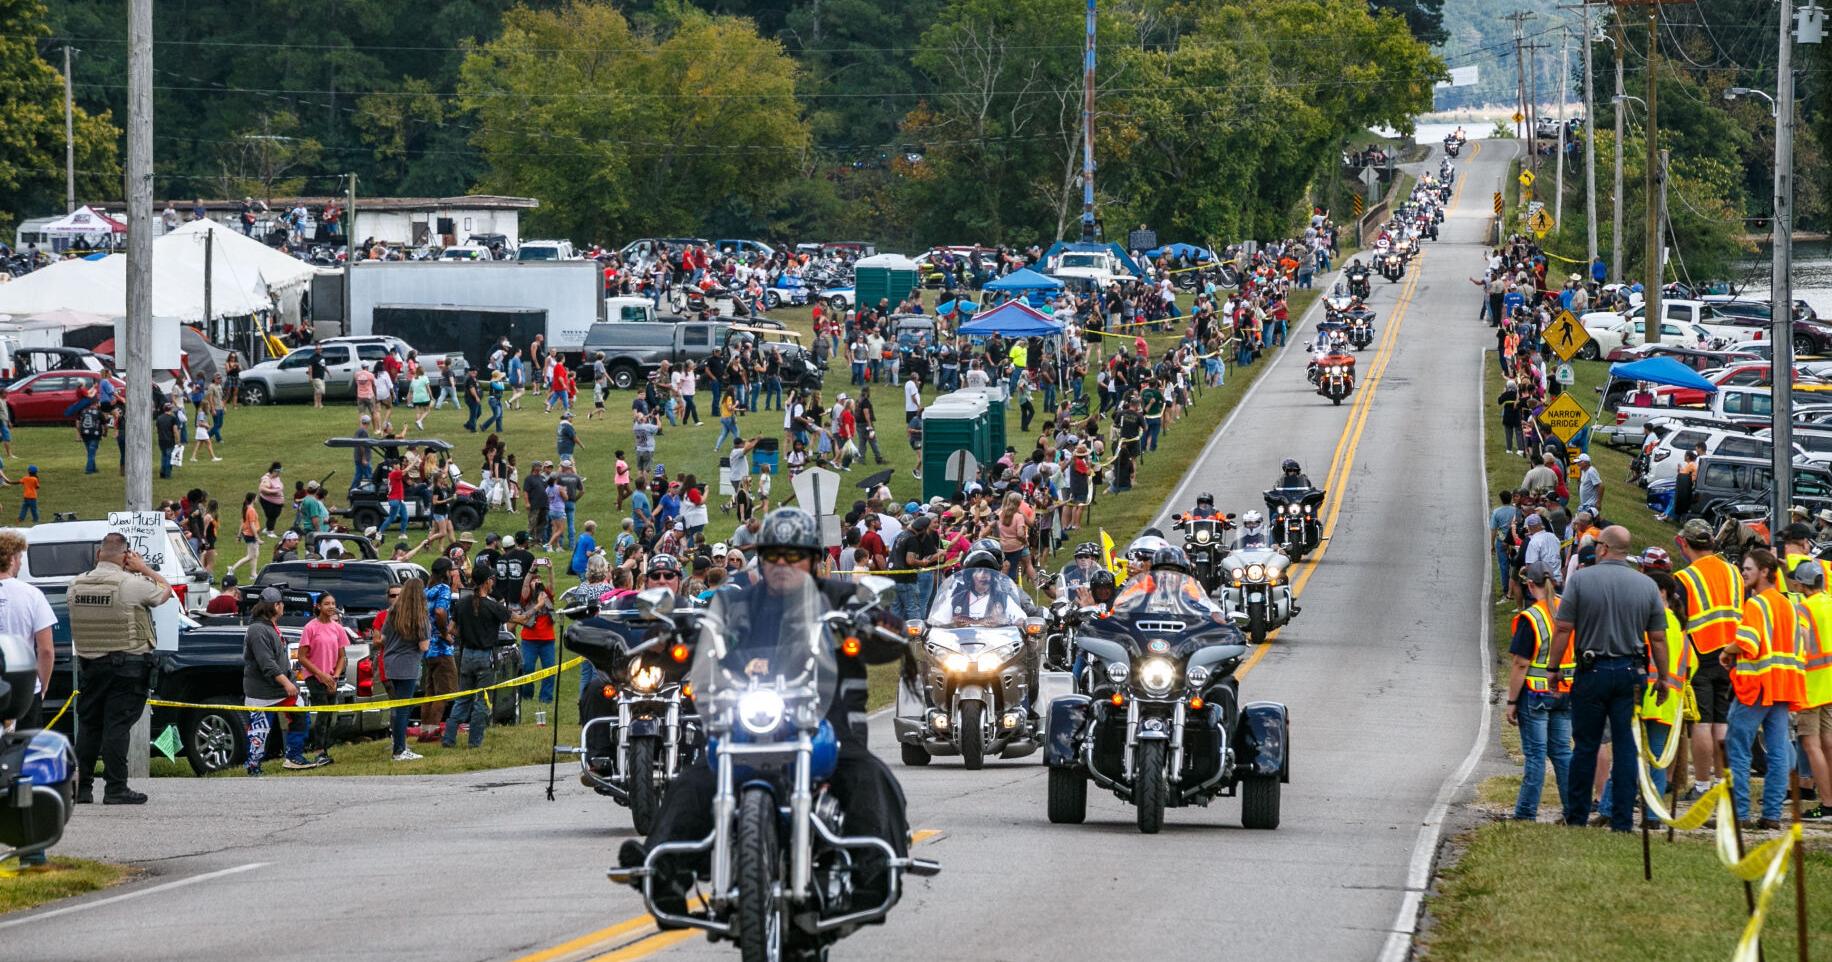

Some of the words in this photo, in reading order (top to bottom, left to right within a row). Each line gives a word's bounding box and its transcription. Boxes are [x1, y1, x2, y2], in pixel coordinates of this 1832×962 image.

[1548, 410, 1581, 419] NARROW
[1551, 419, 1579, 427] BRIDGE
[75, 595, 111, 605] SHERIFF
